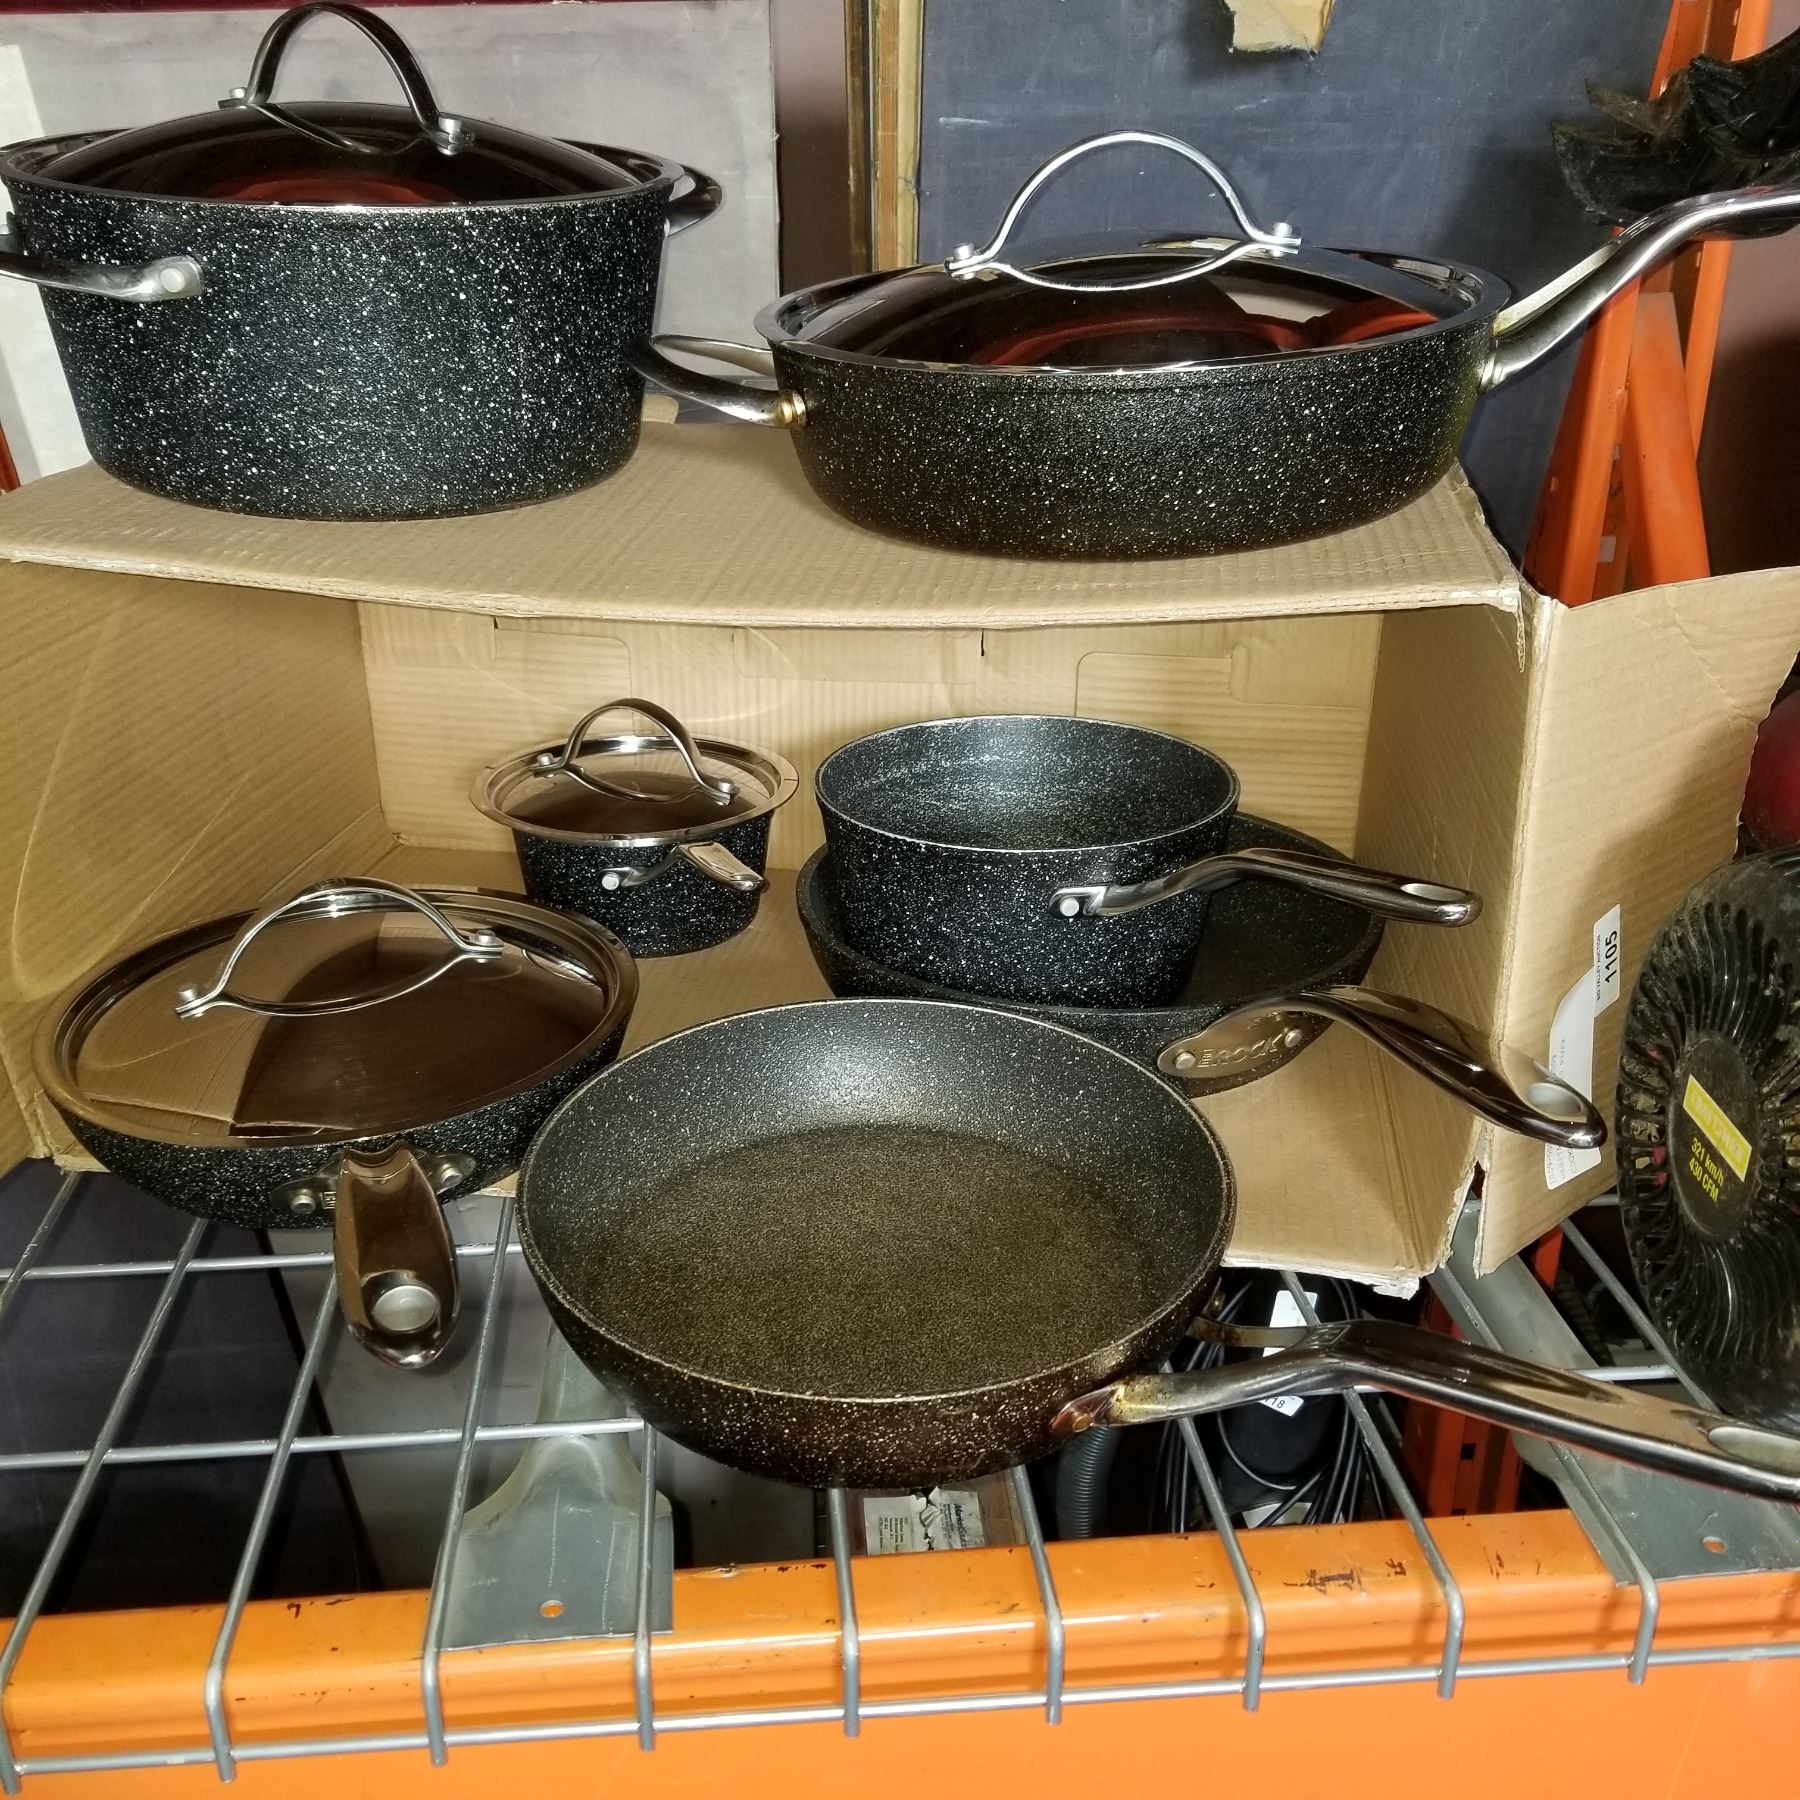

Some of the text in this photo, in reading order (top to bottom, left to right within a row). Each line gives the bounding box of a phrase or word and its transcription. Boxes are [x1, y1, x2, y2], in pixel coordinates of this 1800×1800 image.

[1604, 930, 1618, 983] 1105
[1212, 1033, 1283, 1067] ROCK
[1689, 1157, 1719, 1202] 430 CFM
[1691, 1137, 1724, 1187] 321 km/h
